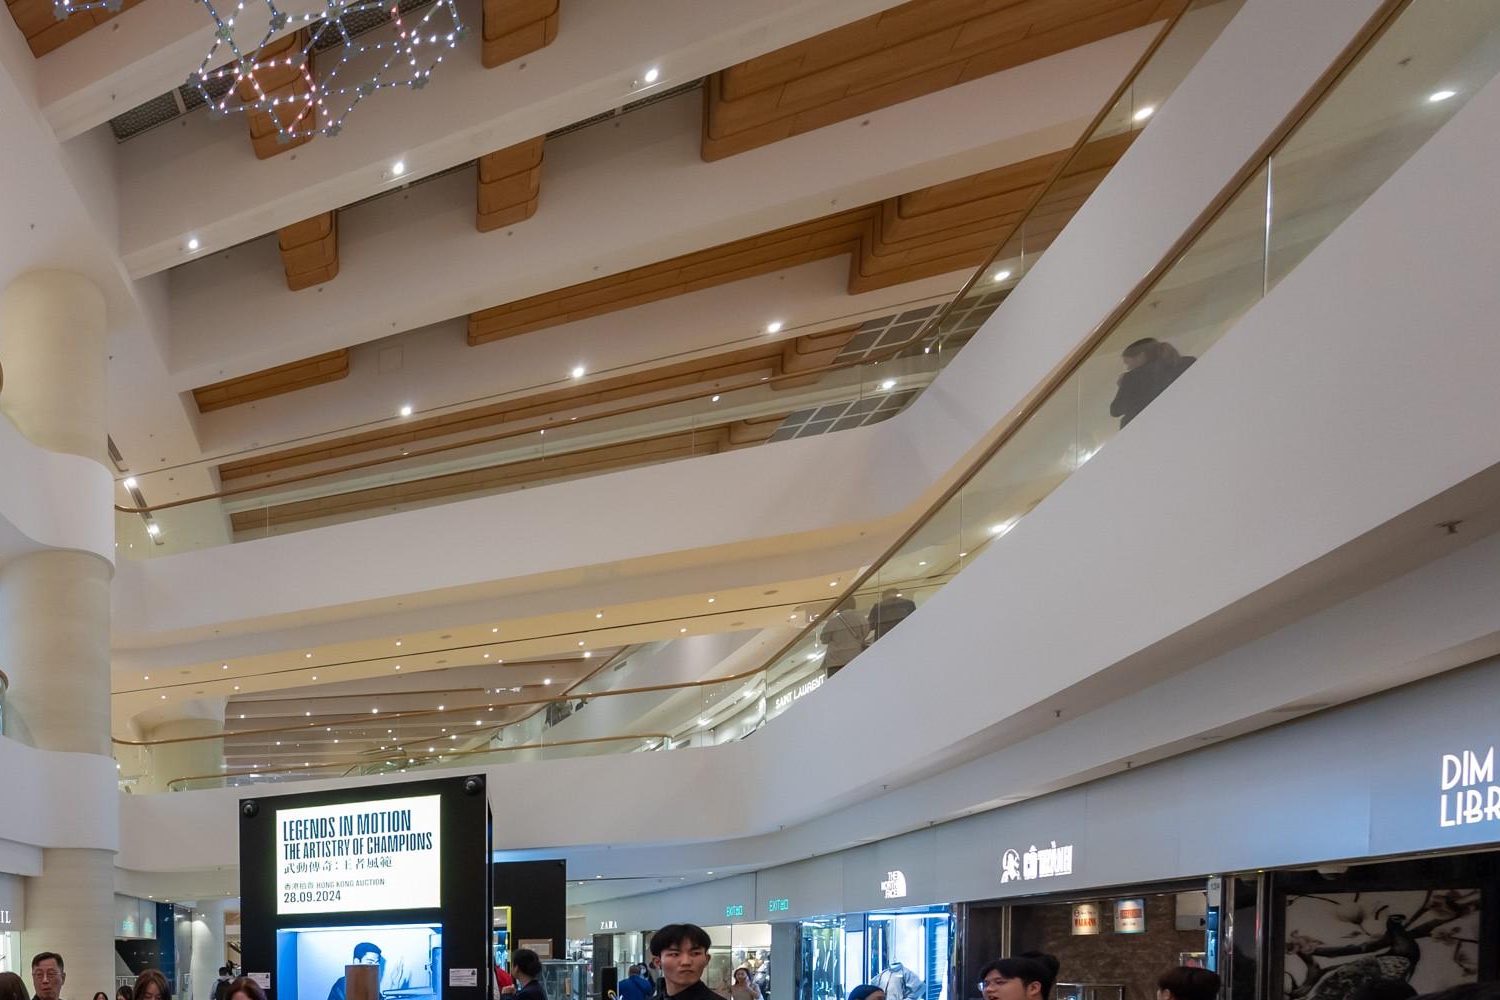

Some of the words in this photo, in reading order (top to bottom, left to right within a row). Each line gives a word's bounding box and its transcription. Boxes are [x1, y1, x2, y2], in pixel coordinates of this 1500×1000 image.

[775, 691, 793, 710] SAINT
[793, 674, 826, 700] LAURENT
[1441, 746, 1494, 791] DIM
[283, 816, 335, 842] LEGENDS
[339, 815, 353, 837] IN
[357, 809, 411, 835] MOTION
[284, 842, 301, 860] THE
[303, 838, 350, 859] ARTISTRY
[353, 837, 364, 855] OF
[367, 831, 433, 854] CHAMPIONS
[284, 889, 341, 904] 28.09.2024
[316, 880, 335, 889] HONG
[336, 879, 355, 888] KONG
[355, 878, 385, 887] AUCTION
[600, 920, 618, 930] ZARA
